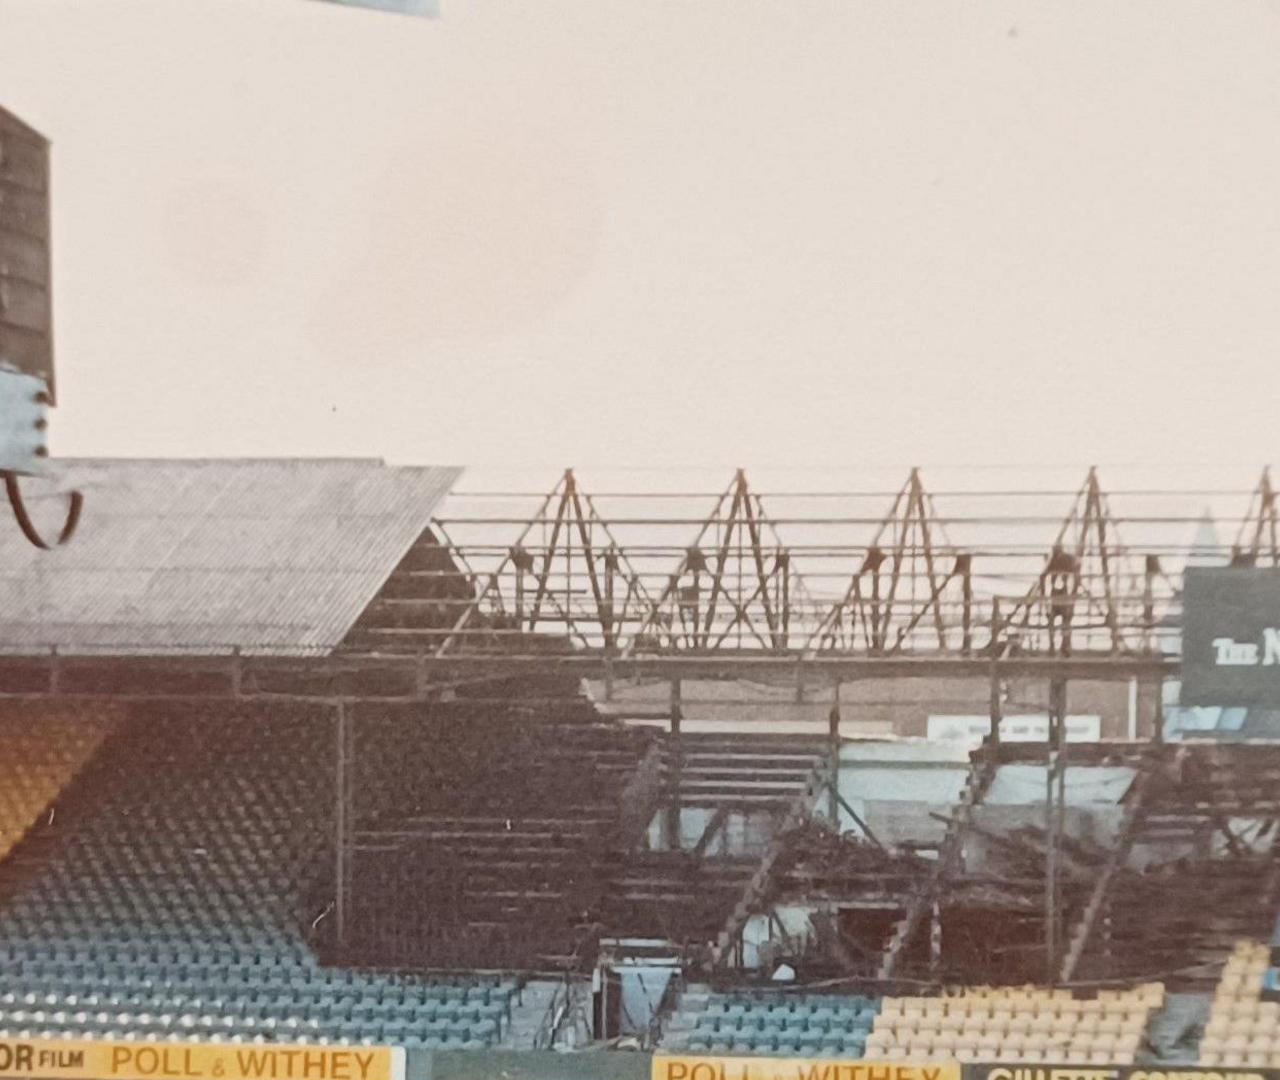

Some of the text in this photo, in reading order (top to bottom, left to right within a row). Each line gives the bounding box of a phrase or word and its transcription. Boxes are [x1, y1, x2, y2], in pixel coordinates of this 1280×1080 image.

[39, 1050, 84, 1068] FILM
[111, 1046, 203, 1076] POLL
[211, 1057, 225, 1077] &
[236, 1050, 375, 1080] WITHEY
